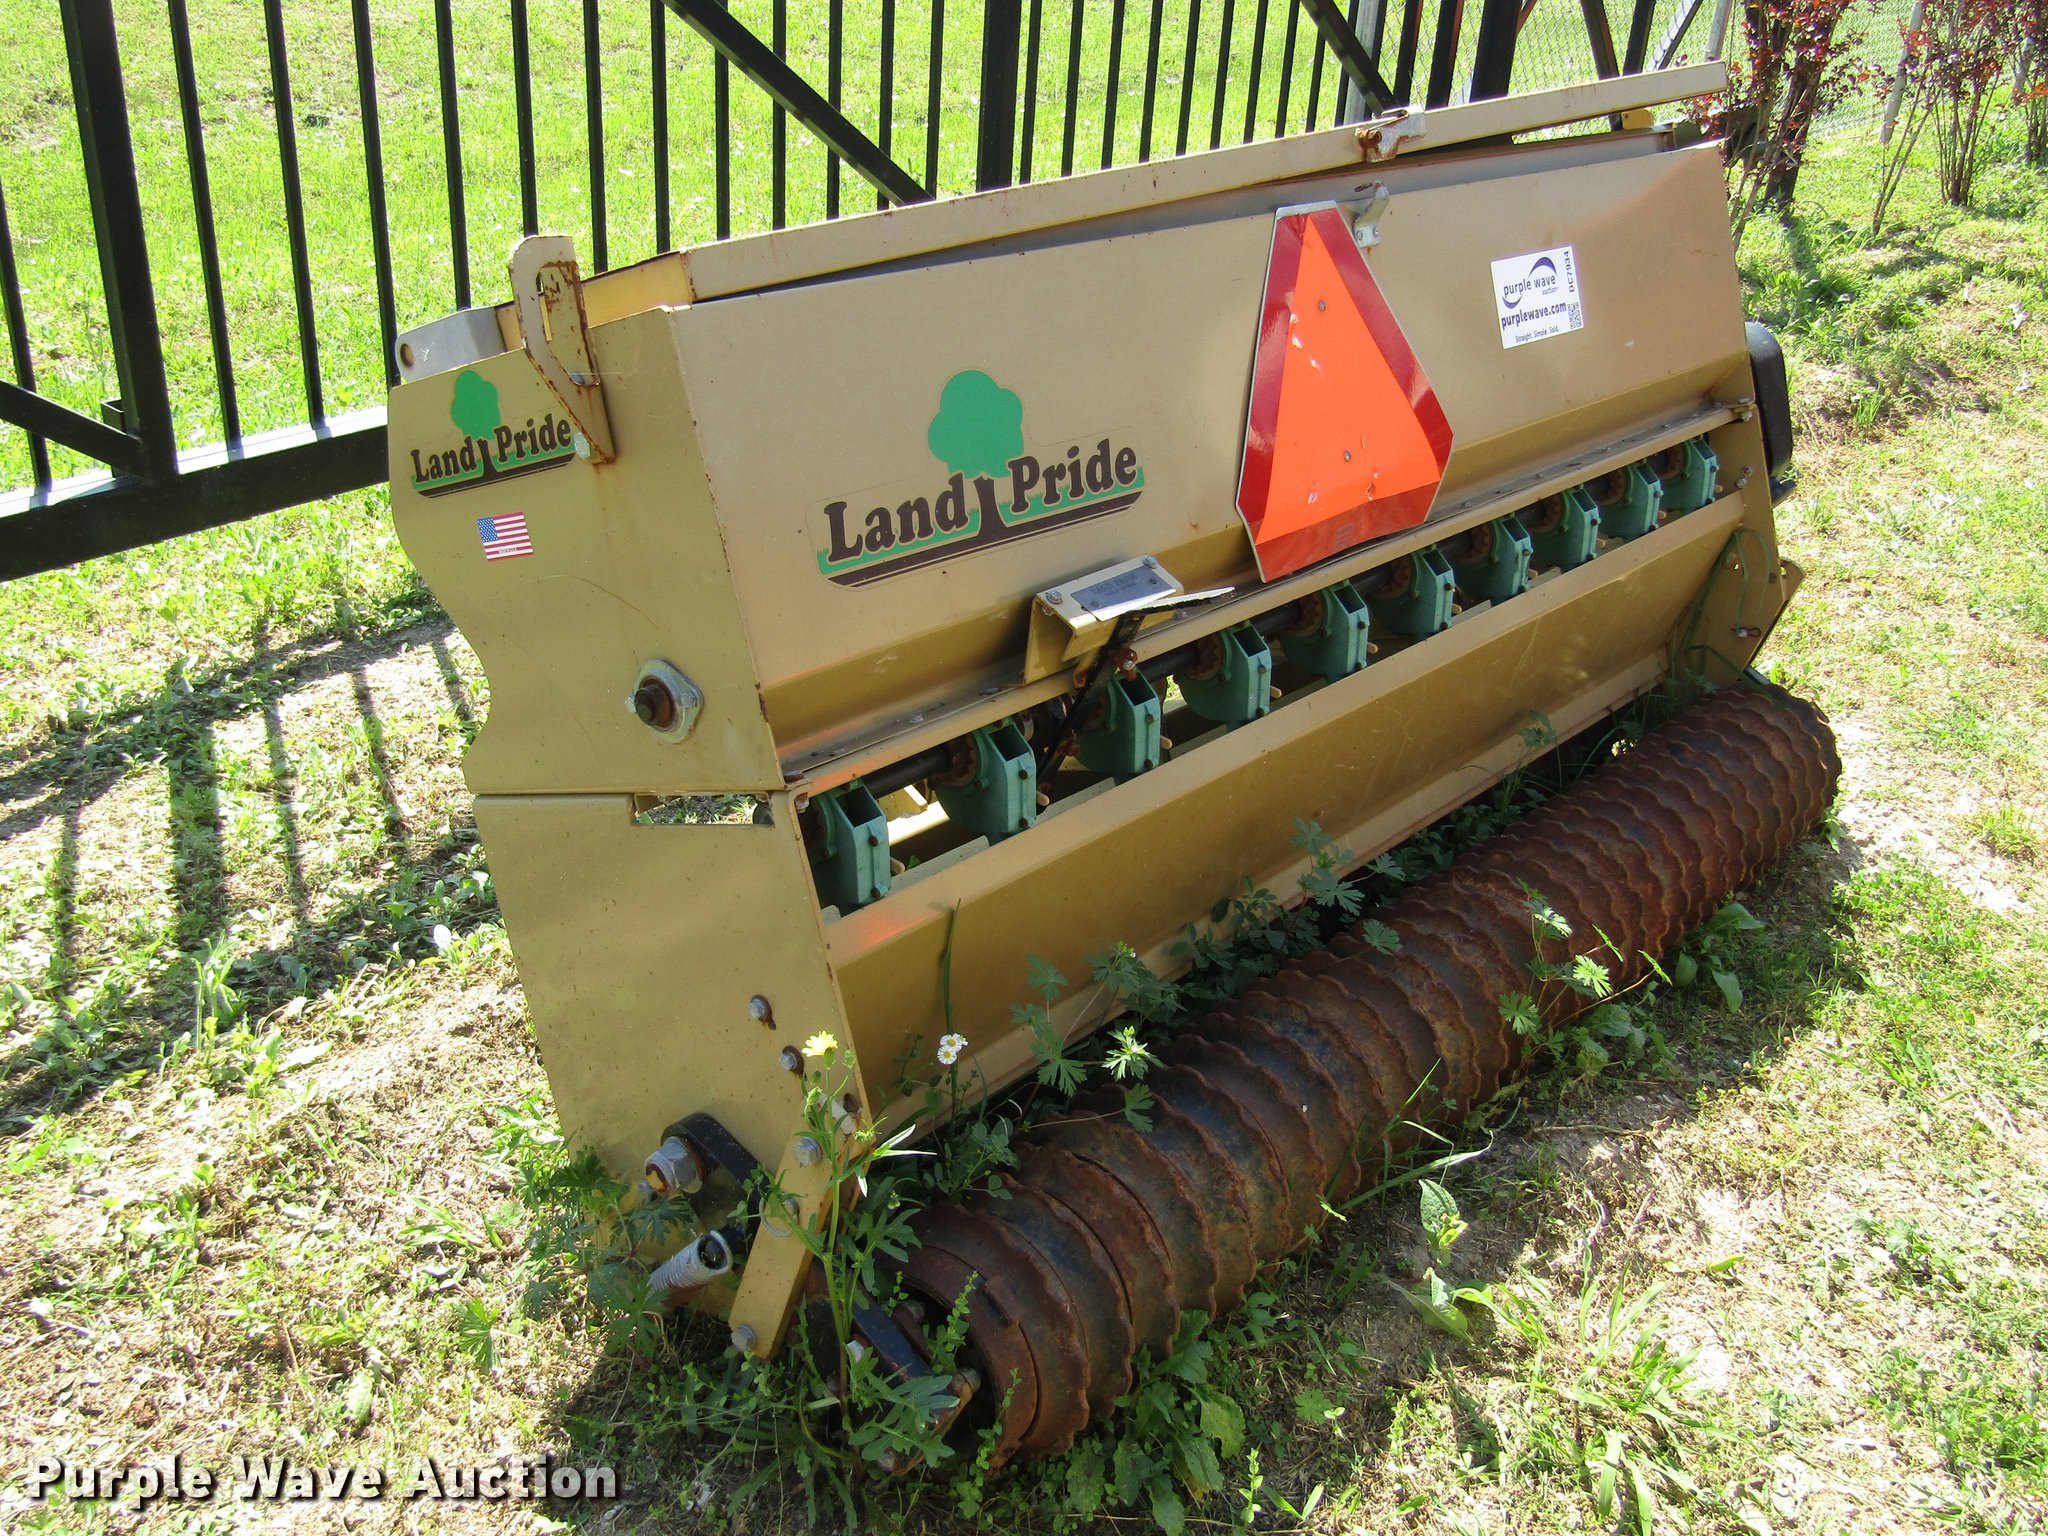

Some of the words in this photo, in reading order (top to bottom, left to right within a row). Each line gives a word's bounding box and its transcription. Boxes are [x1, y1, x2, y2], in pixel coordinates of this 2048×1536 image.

[1503, 279, 1532, 298] purple
[1533, 275, 1556, 288] wave
[1563, 251, 1575, 293] DC7934
[1501, 302, 1567, 330] purplewave.com
[411, 435, 478, 483] Land
[494, 412, 572, 463] Pride
[824, 472, 969, 562] Land
[1007, 438, 1137, 513] Pride
